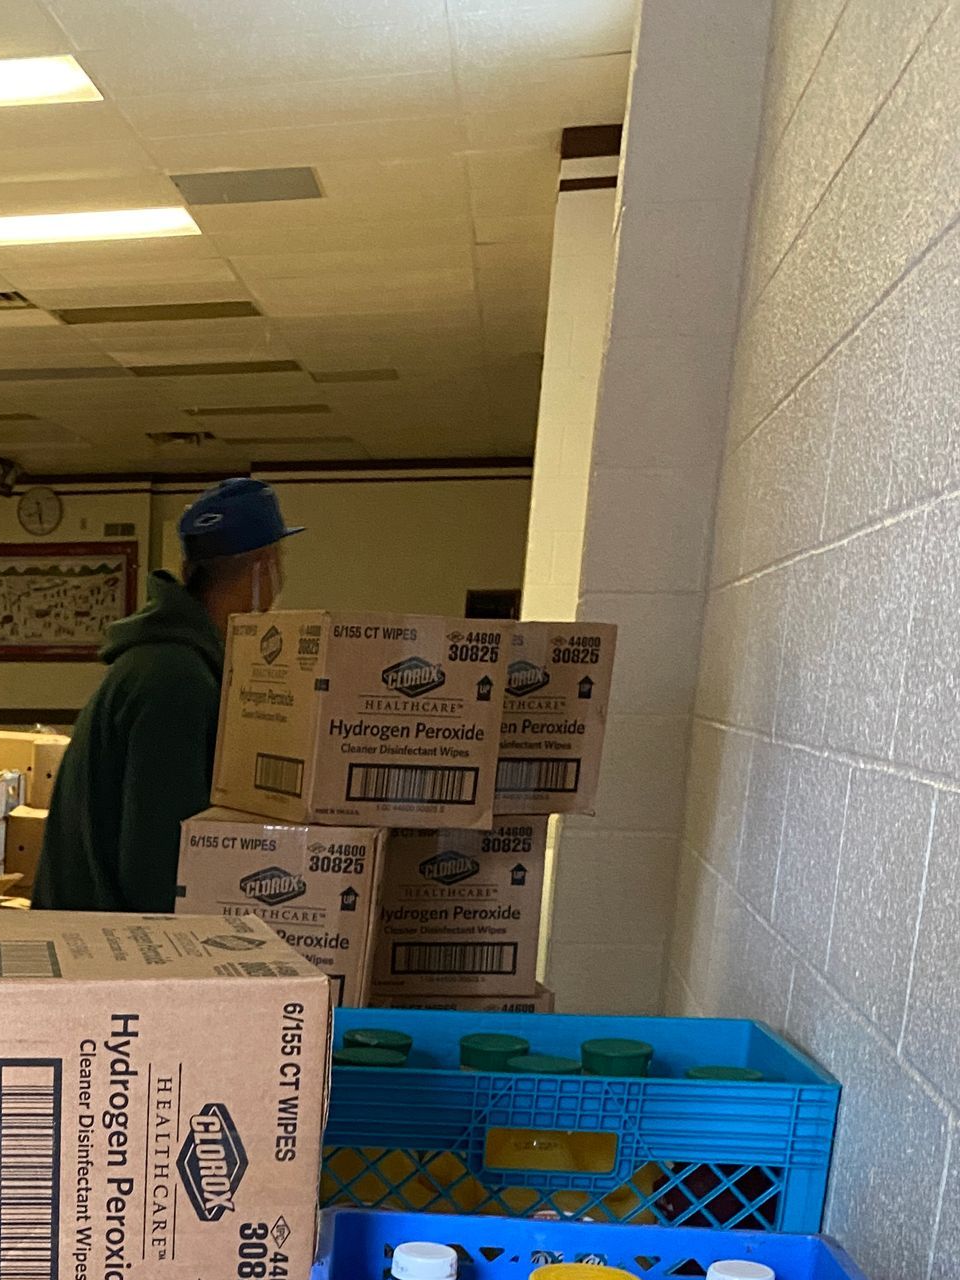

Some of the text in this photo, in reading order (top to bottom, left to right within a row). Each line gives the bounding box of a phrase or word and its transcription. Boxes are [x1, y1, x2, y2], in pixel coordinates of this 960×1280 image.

[333, 626, 417, 641] 6/155 CT WIPES
[448, 644, 498, 663] 30825
[552, 648, 599, 664] 30825
[387, 664, 442, 690] CLOROX
[329, 719, 410, 741] Hydrogen
[415, 722, 485, 741] Peroxide
[521, 719, 586, 735] Peroxide
[341, 743, 470, 758] Cleaner Disinfectant Wipes
[190, 836, 277, 851] 6/155 CT WIPES
[327, 844, 366, 857] 44600
[481, 837, 533, 853] 30825
[309, 855, 365, 875] 30825
[424, 857, 474, 879] CLOROX
[246, 873, 303, 897] CLOROX
[453, 905, 521, 920] Peroxide
[78, 1038, 97, 1111] Cleaner
[274, 1001, 304, 1163] 6/155 CT WIPES
[103, 1013, 140, 1167] Hydrogen
[76, 1113, 94, 1211] Disinfectant
[189, 1112, 236, 1214] CLOROX
